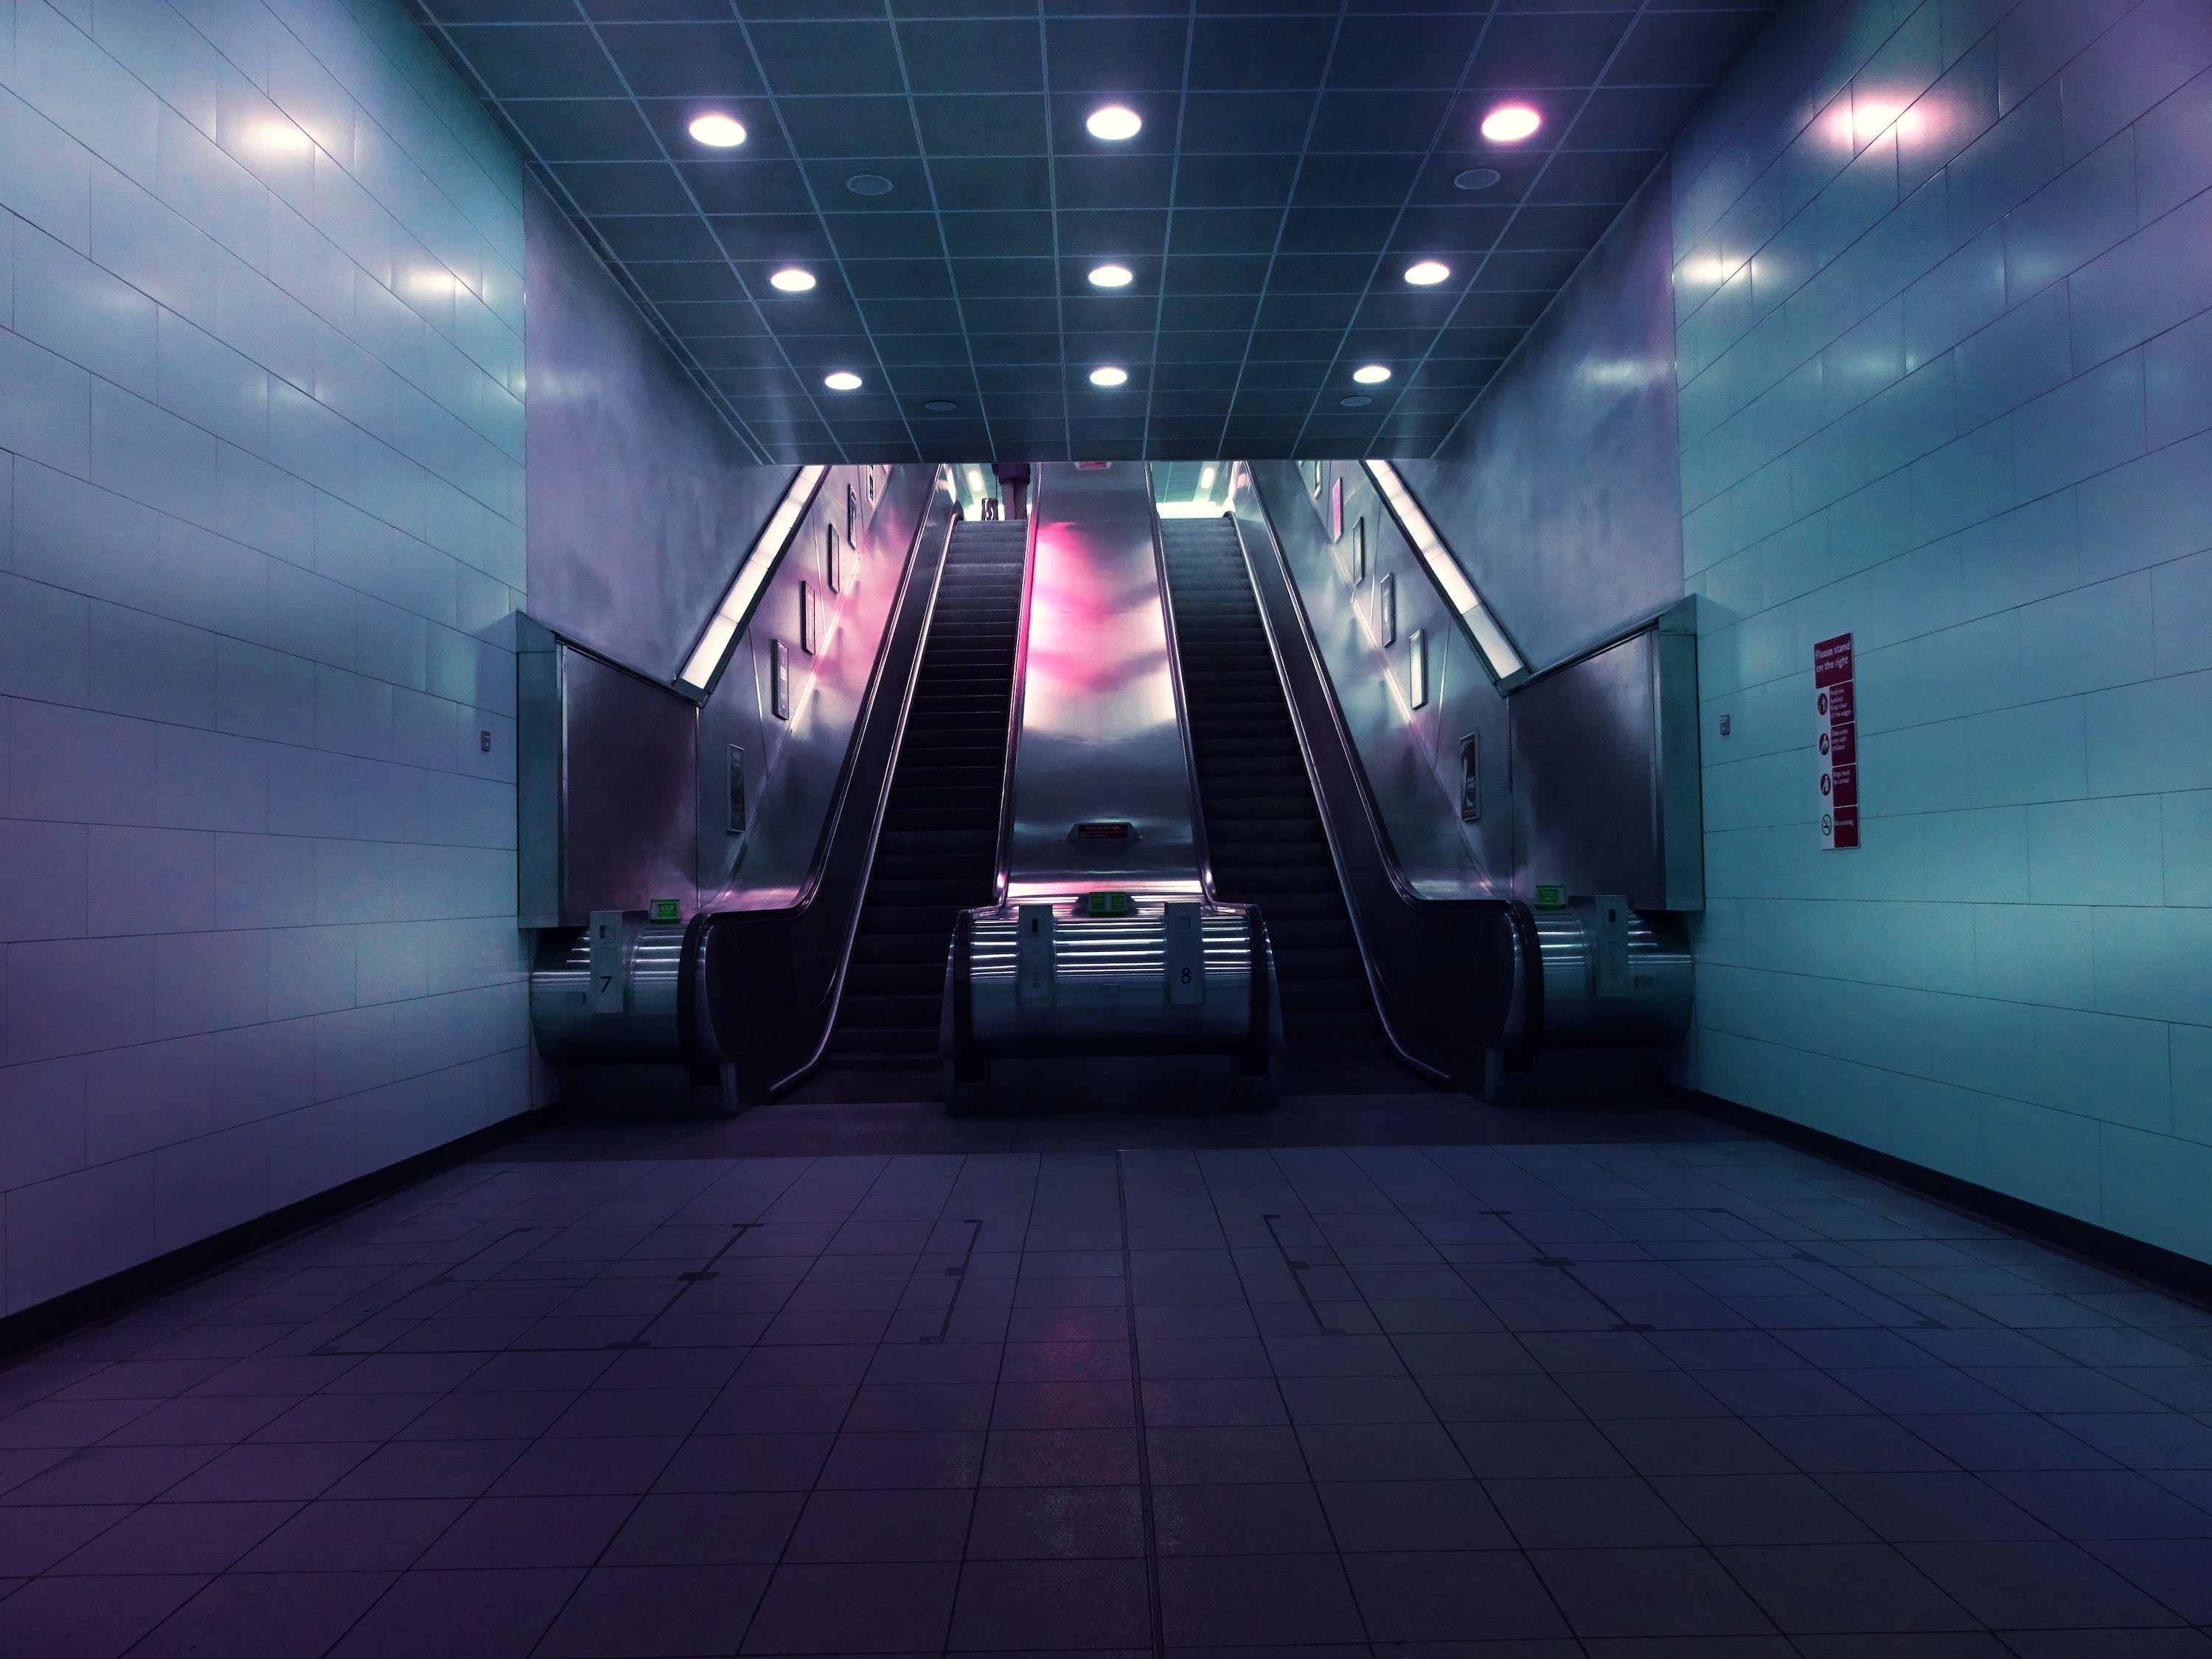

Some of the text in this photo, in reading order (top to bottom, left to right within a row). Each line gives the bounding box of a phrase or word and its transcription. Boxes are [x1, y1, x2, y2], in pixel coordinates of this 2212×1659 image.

[1815, 640, 1850, 659] Please stand
[1824, 661, 1834, 670] the
[1835, 656, 1848, 669] right
[600, 975, 613, 993] 7
[1180, 967, 1192, 984] 8
